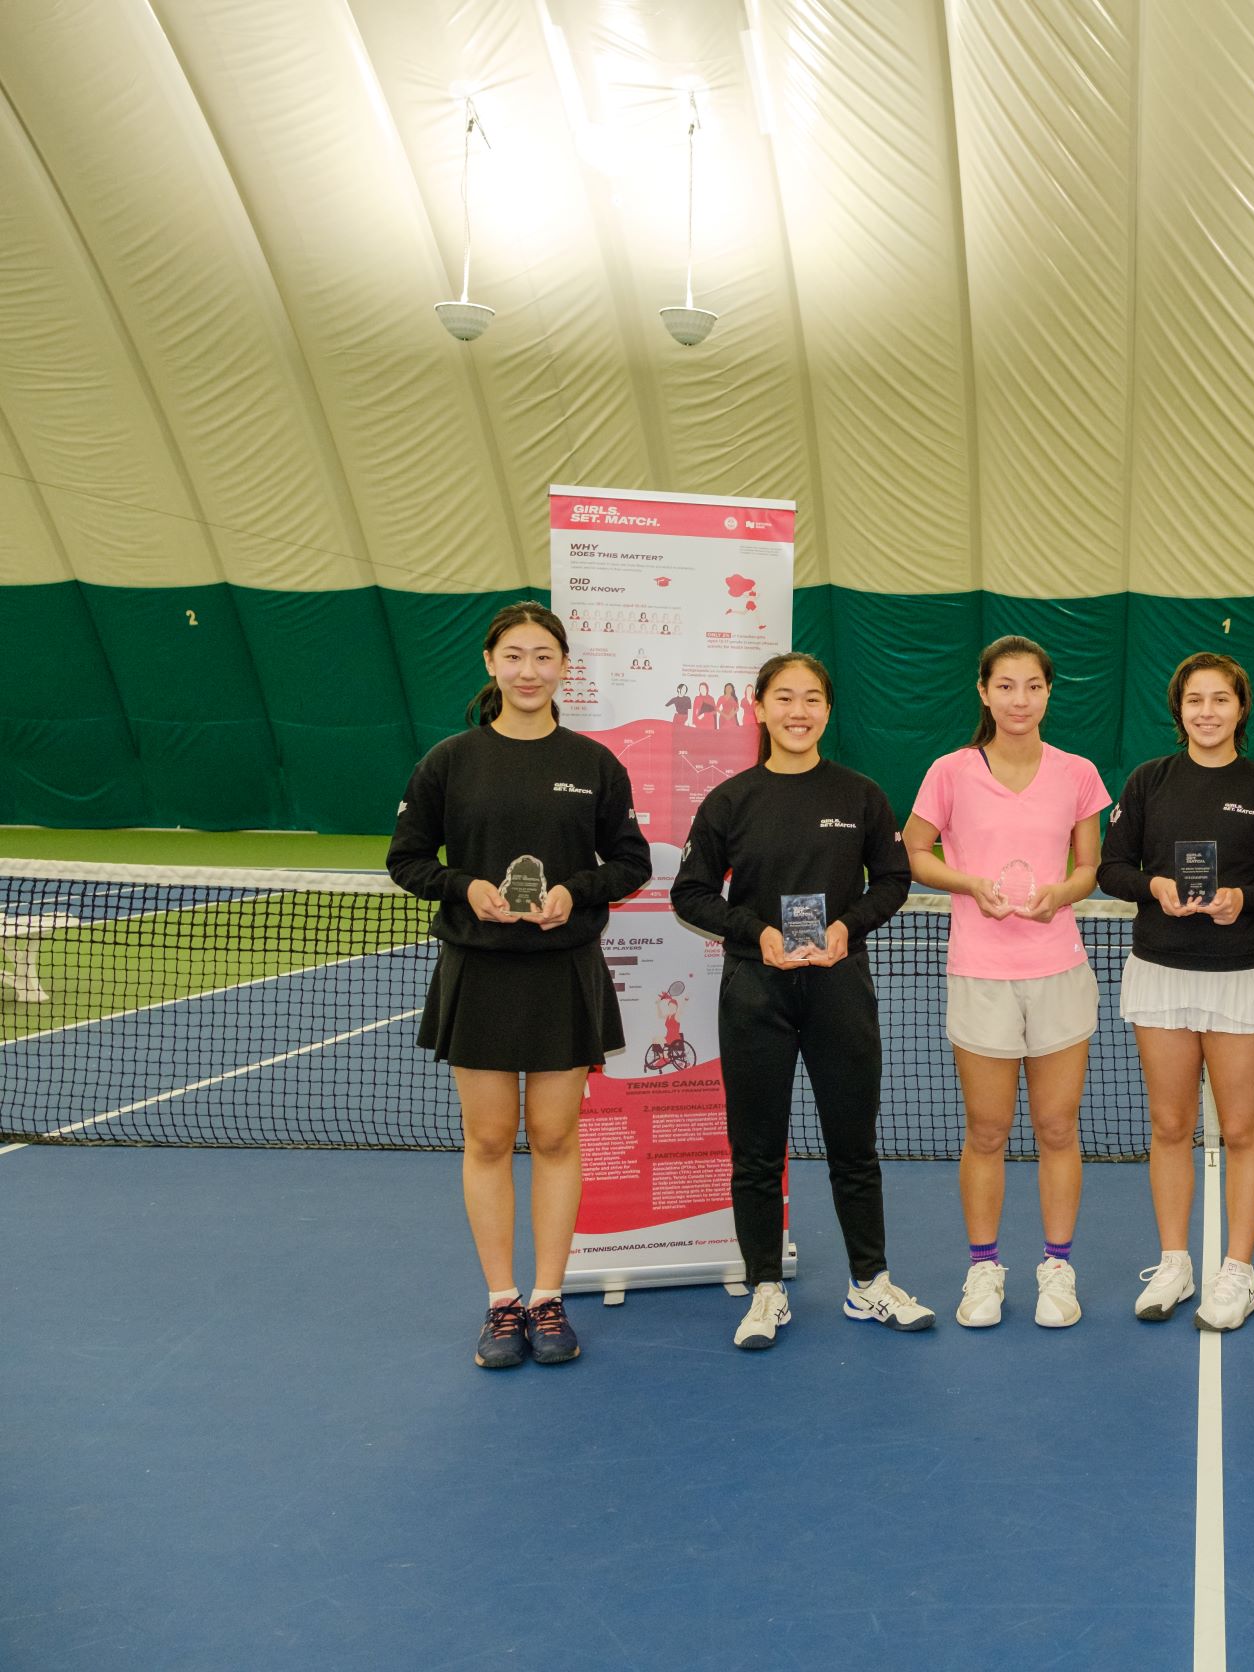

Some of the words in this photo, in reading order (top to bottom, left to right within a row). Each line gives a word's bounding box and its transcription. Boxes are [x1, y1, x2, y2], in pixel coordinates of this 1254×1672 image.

[573, 505, 620, 515] GIRLS.
[570, 514, 600, 523] SET.
[605, 515, 660, 526] MATCH.
[620, 553, 664, 561] MATTER?
[186, 610, 198, 625] 2
[1222, 618, 1230, 633] 1
[627, 1081, 669, 1089] TENNIS
[672, 1079, 720, 1088] CANADA
[583, 1240, 693, 1253] TENNISCANADA.COM/GIRLS
